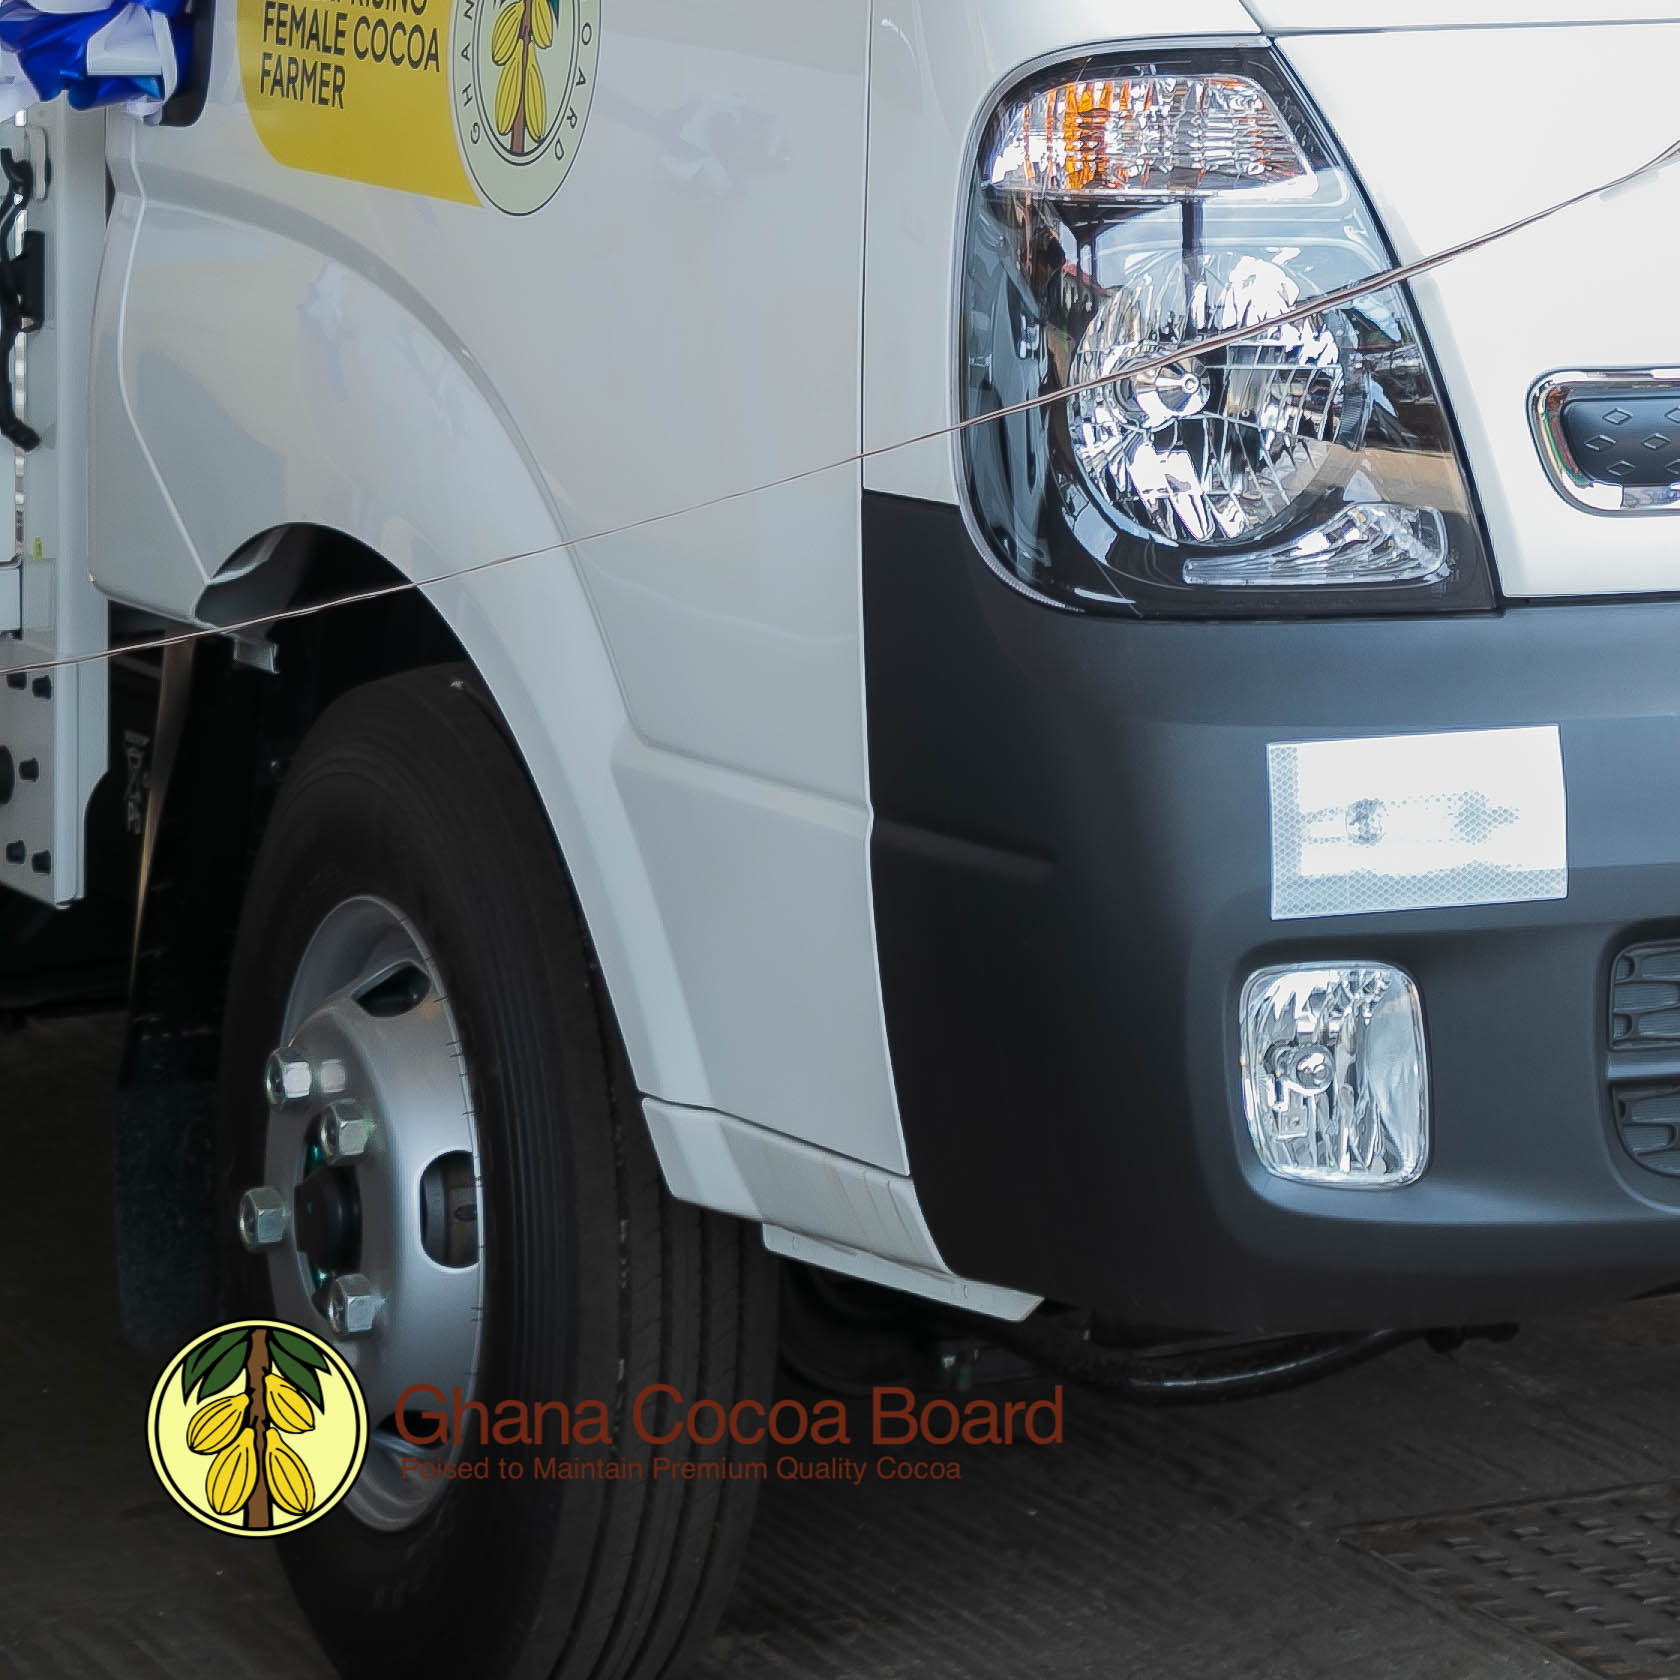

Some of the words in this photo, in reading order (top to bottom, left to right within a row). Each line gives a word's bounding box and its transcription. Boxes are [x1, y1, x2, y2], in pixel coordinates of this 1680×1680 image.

[263, 0, 349, 57] FEMALE
[352, 15, 440, 73] COCOA
[260, 51, 346, 110] FARMER
